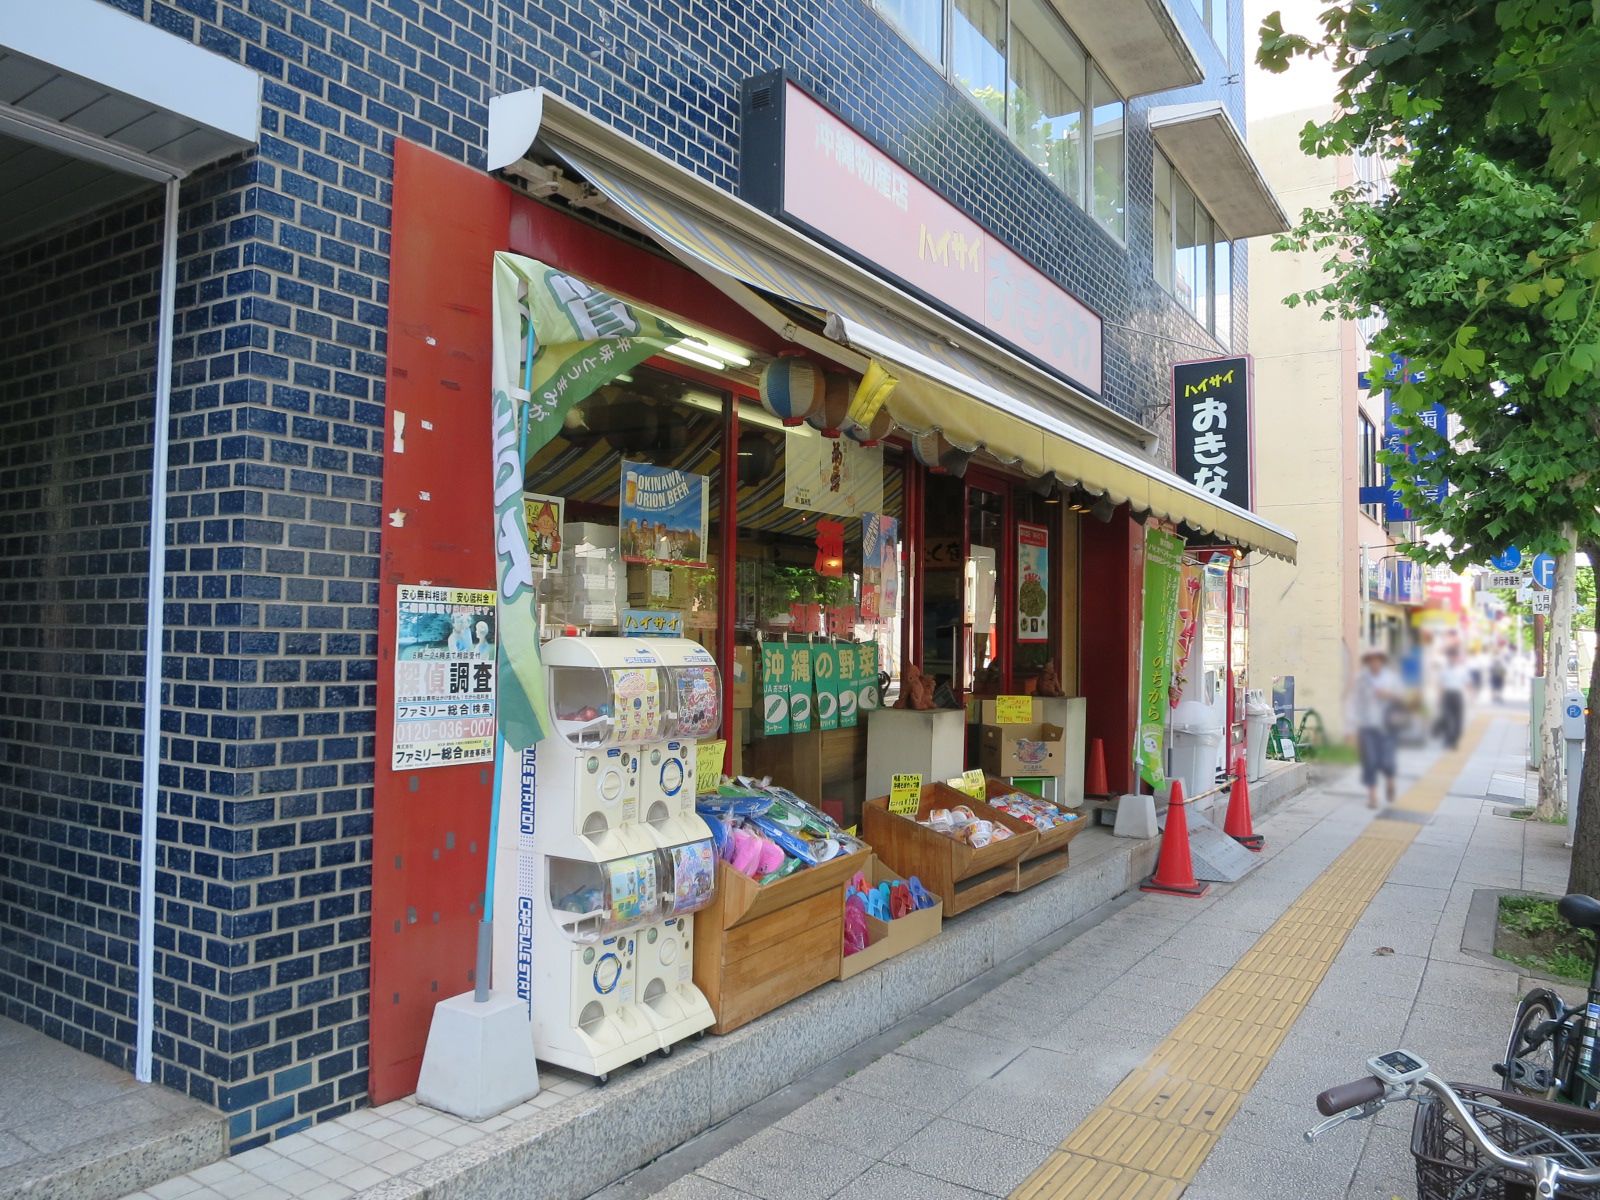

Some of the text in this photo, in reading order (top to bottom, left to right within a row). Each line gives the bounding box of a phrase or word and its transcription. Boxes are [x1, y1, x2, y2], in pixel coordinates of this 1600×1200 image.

[918, 223, 981, 272] ハイサイ
[988, 254, 1092, 371] おきなわ
[1184, 369, 1235, 398] ハイサイ
[1192, 397, 1229, 497] おきな
[637, 469, 685, 492] OKINAWA,
[636, 482, 690, 508] ORION BEER
[1493, 576, 1520, 586] 歩行者優先
[401, 589, 453, 602] 安心無料相談！
[624, 615, 679, 631] ハイサイ
[764, 645, 875, 683] 沖縄の野菜
[398, 662, 493, 695] 探偵調査
[399, 703, 491, 718] ファミリー総合 検索
[396, 719, 493, 741] 0120-036-007
[517, 897, 533, 1001] CAPSULE STAT
